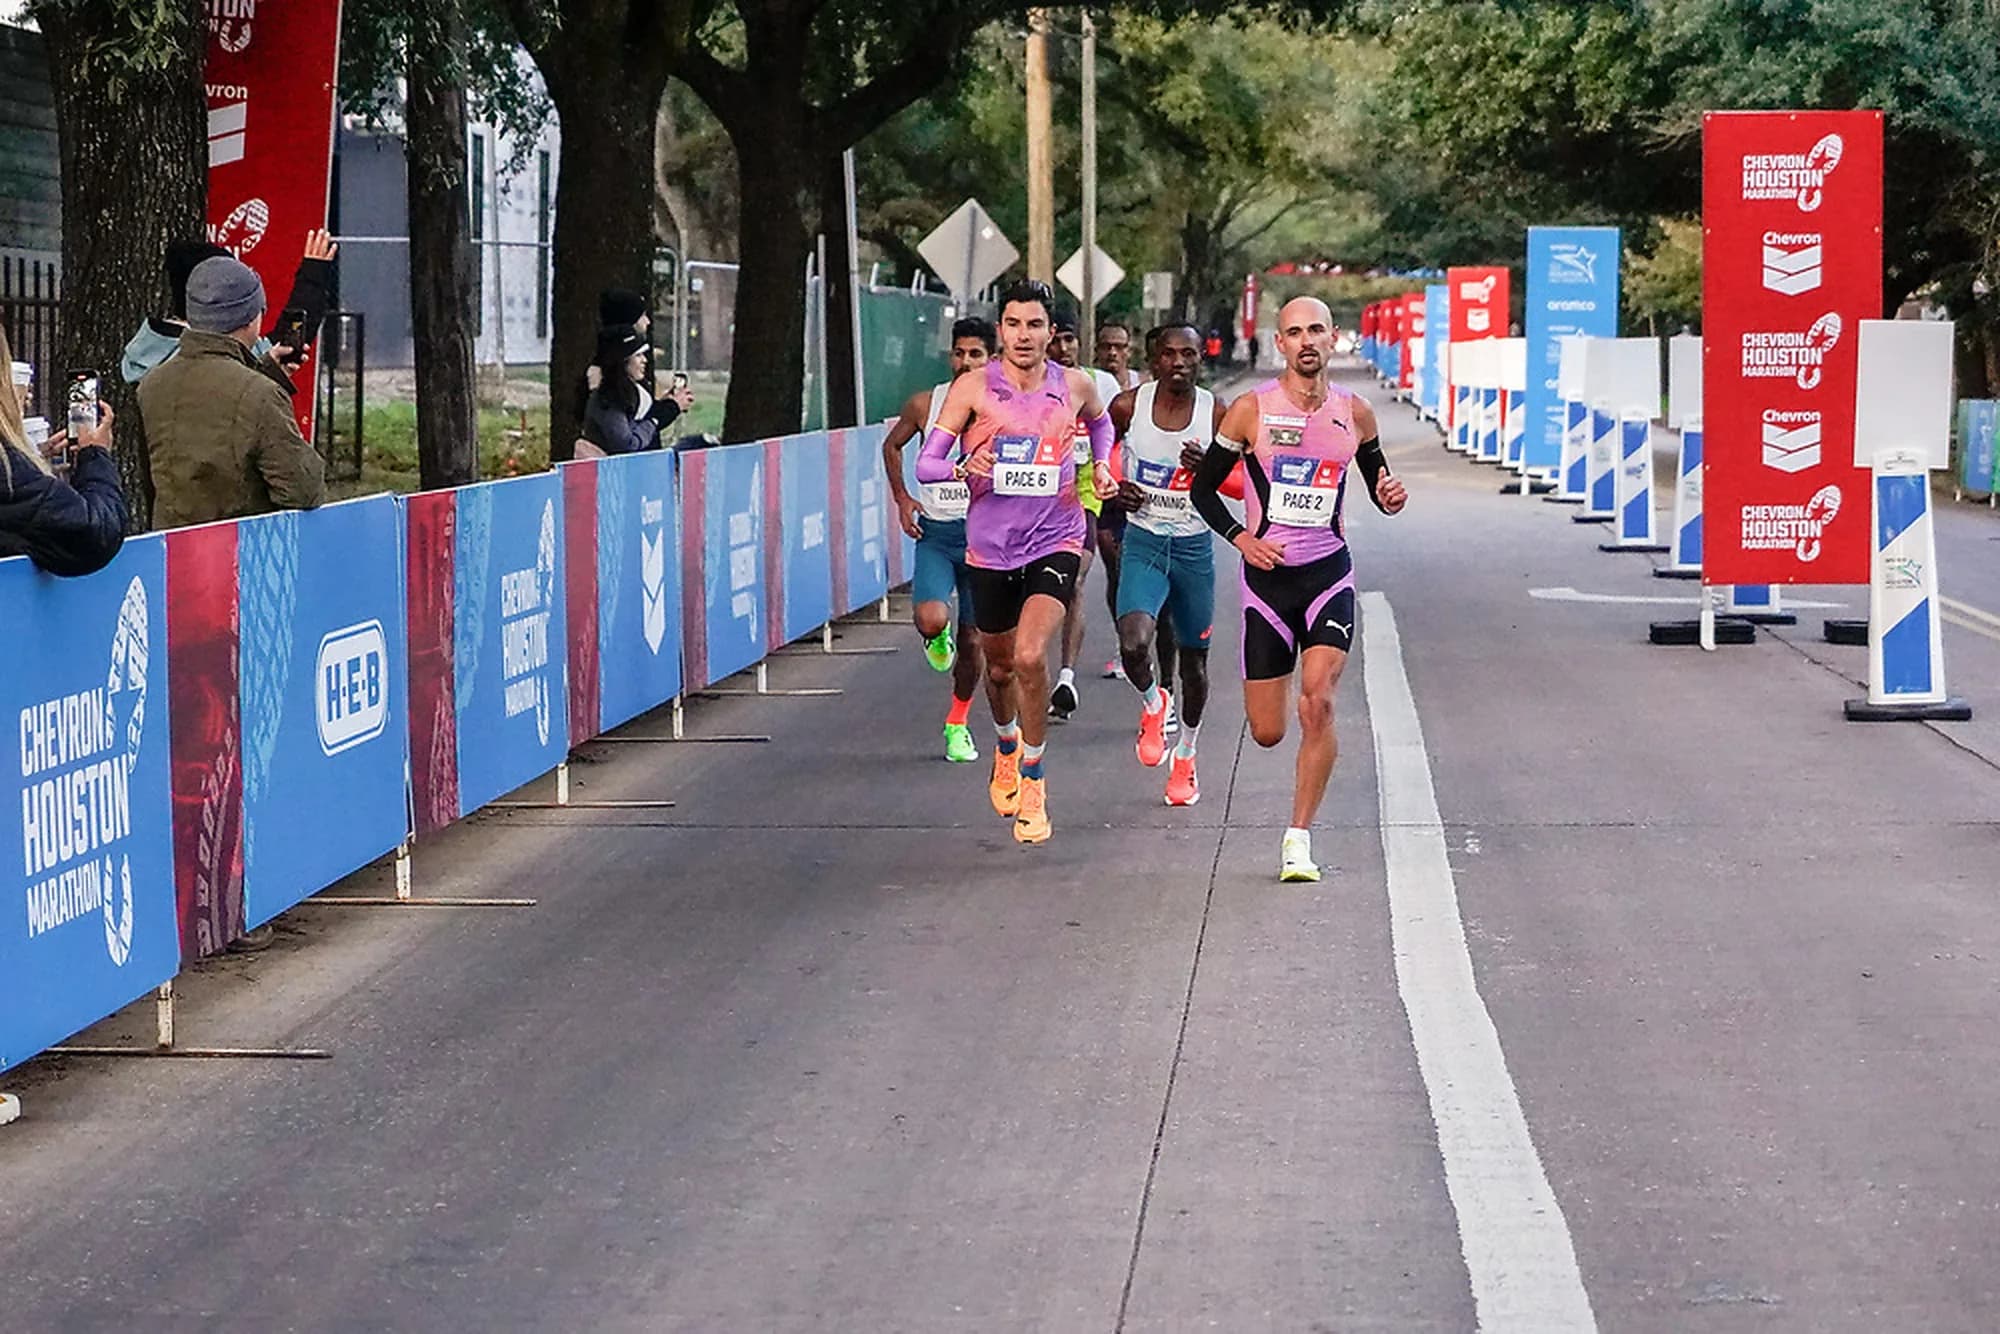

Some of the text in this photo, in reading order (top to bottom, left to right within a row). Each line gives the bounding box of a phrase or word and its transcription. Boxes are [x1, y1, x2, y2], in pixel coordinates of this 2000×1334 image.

[204, 83, 248, 99] vron
[1743, 155, 1805, 169] CHEVRON
[1743, 169, 1824, 188] HOUSTON
[1763, 231, 1822, 245] Chevron
[1547, 301, 1596, 312] aramco
[1742, 333, 1804, 347] CHEVRON
[1742, 347, 1822, 365] HOUSTON
[1742, 366, 1797, 377] MARATHON
[1762, 409, 1821, 422] Chevron
[1005, 471, 1047, 487] PACE 6
[939, 487, 969, 501] ZOUHA
[1283, 491, 1324, 510] PACE 2
[1741, 505, 1804, 519] CHEVRON
[1741, 520, 1821, 537] HOUSTON
[20, 687, 104, 777] CHEVRON
[21, 754, 131, 877] HOUSTON
[26, 859, 102, 938] MARATHON
